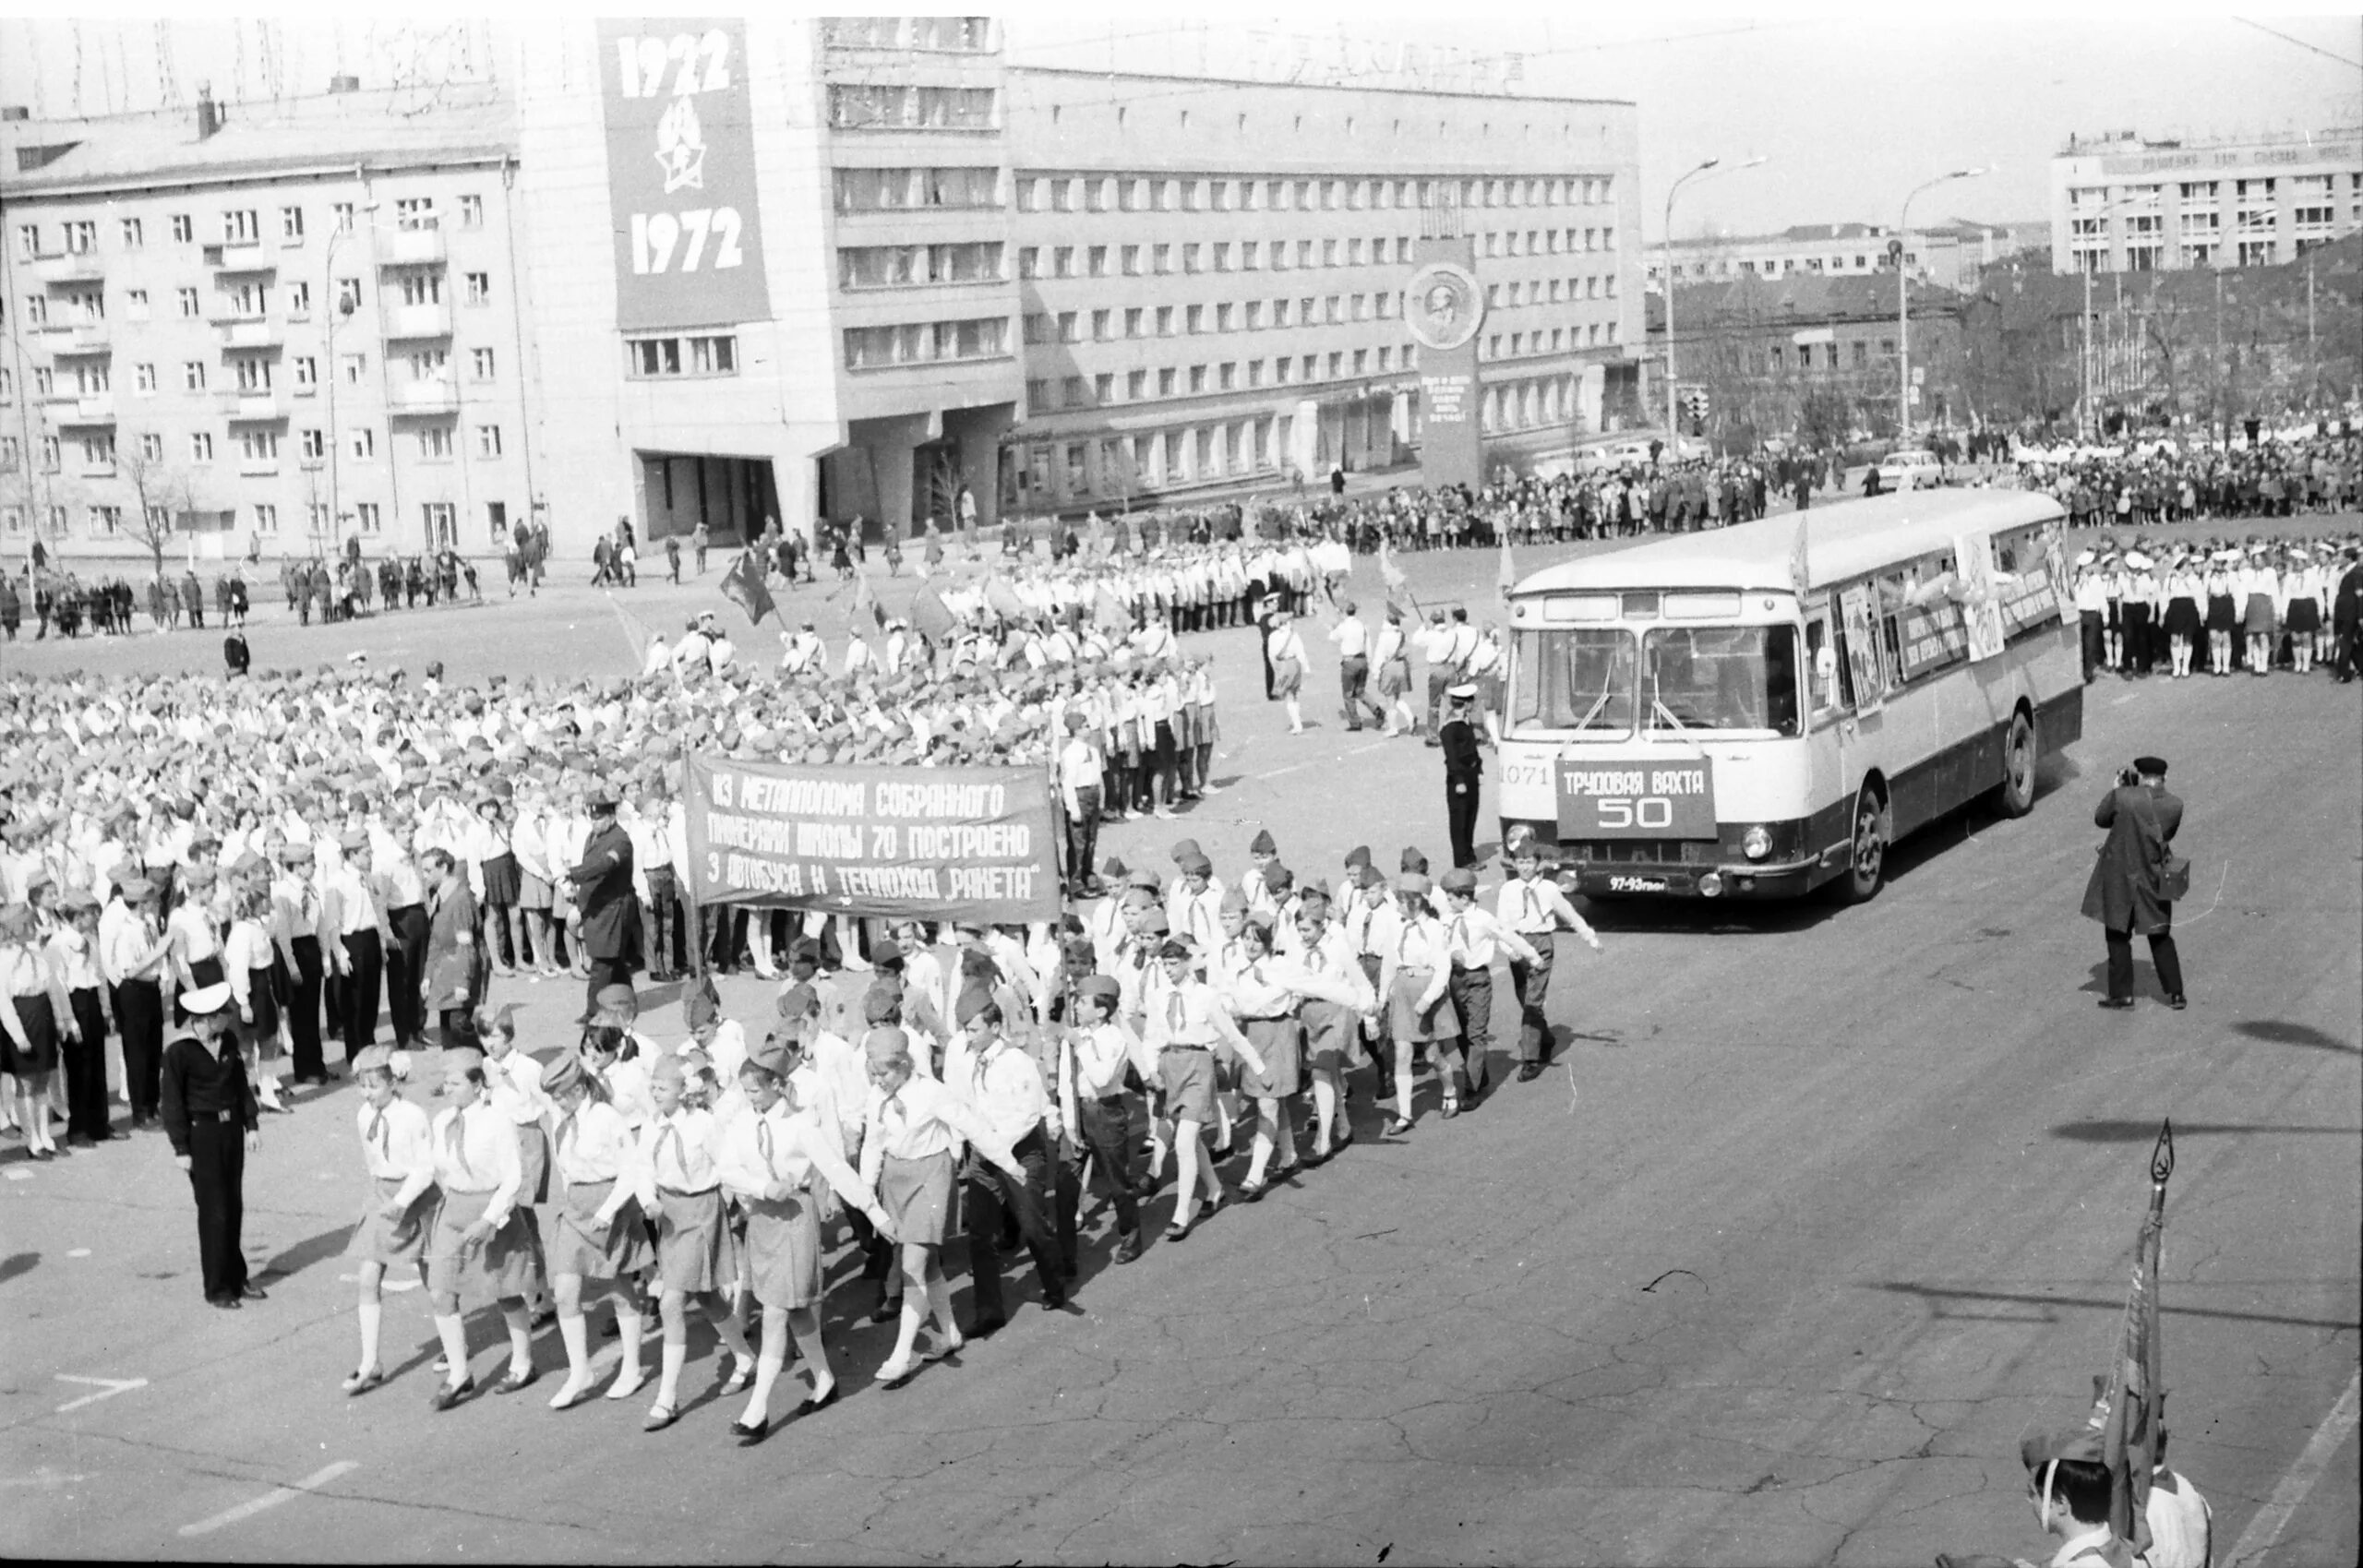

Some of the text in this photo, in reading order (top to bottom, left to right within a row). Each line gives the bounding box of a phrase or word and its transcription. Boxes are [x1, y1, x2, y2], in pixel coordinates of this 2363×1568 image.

[617, 28, 730, 98] 1922
[630, 206, 742, 275] 1972
[713, 773, 1004, 818] ИЗ МЕТАЛЛОЛОМА СОБРАННОГО
[1564, 770, 1704, 796] ТРУДОВАЯ ВАХТА
[1598, 797, 1672, 828] 50
[797, 821, 863, 859] ШКОЛЫ
[871, 824, 897, 859] 70
[908, 824, 1030, 859] ПОСТРОЕНО
[707, 852, 720, 883] 3
[726, 853, 804, 896] АВТОБУСА
[810, 864, 829, 894] И
[834, 866, 940, 899] ТЕПЛОХОД
